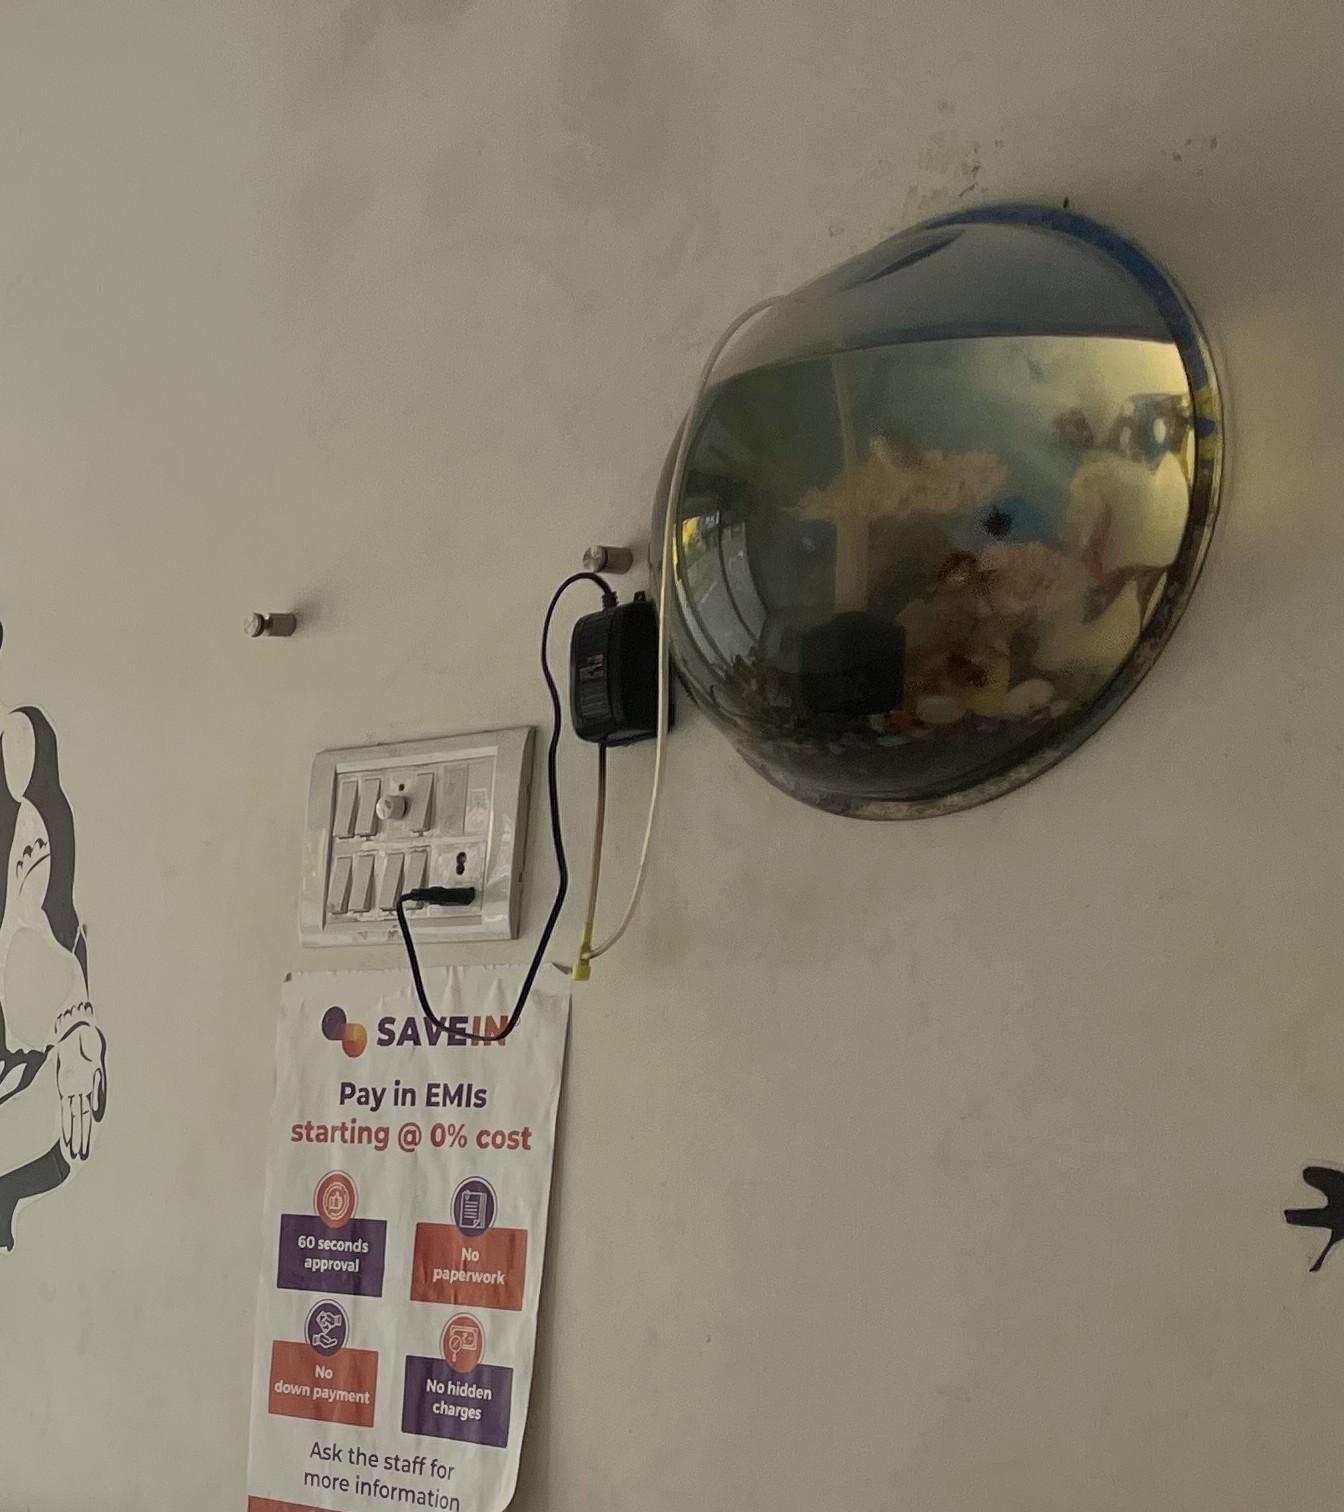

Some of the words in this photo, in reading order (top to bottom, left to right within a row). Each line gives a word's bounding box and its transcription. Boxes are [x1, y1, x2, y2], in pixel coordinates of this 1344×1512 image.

[376, 1014, 510, 1047] SAVEIN
[339, 1081, 387, 1112] Pay
[393, 1079, 417, 1107] in
[425, 1082, 488, 1109] EMIs
[290, 1118, 390, 1152] starting
[397, 1121, 422, 1153] @
[430, 1122, 468, 1149] 0%
[476, 1125, 532, 1151] cost
[297, 1234, 315, 1250] 60
[317, 1236, 369, 1253] seconds
[462, 1247, 480, 1262] No
[304, 1257, 359, 1273] approval
[432, 1267, 506, 1285] paperwork
[315, 1364, 333, 1379] No
[274, 1379, 311, 1398] down
[313, 1388, 371, 1405] payment
[426, 1378, 445, 1395] No
[447, 1380, 492, 1401] hidden
[432, 1400, 482, 1421] charges
[310, 1441, 343, 1463] Ask
[348, 1446, 379, 1468] the
[383, 1453, 428, 1476] staff
[430, 1458, 455, 1481] for
[303, 1471, 350, 1493] more
[355, 1475, 461, 1512] information
